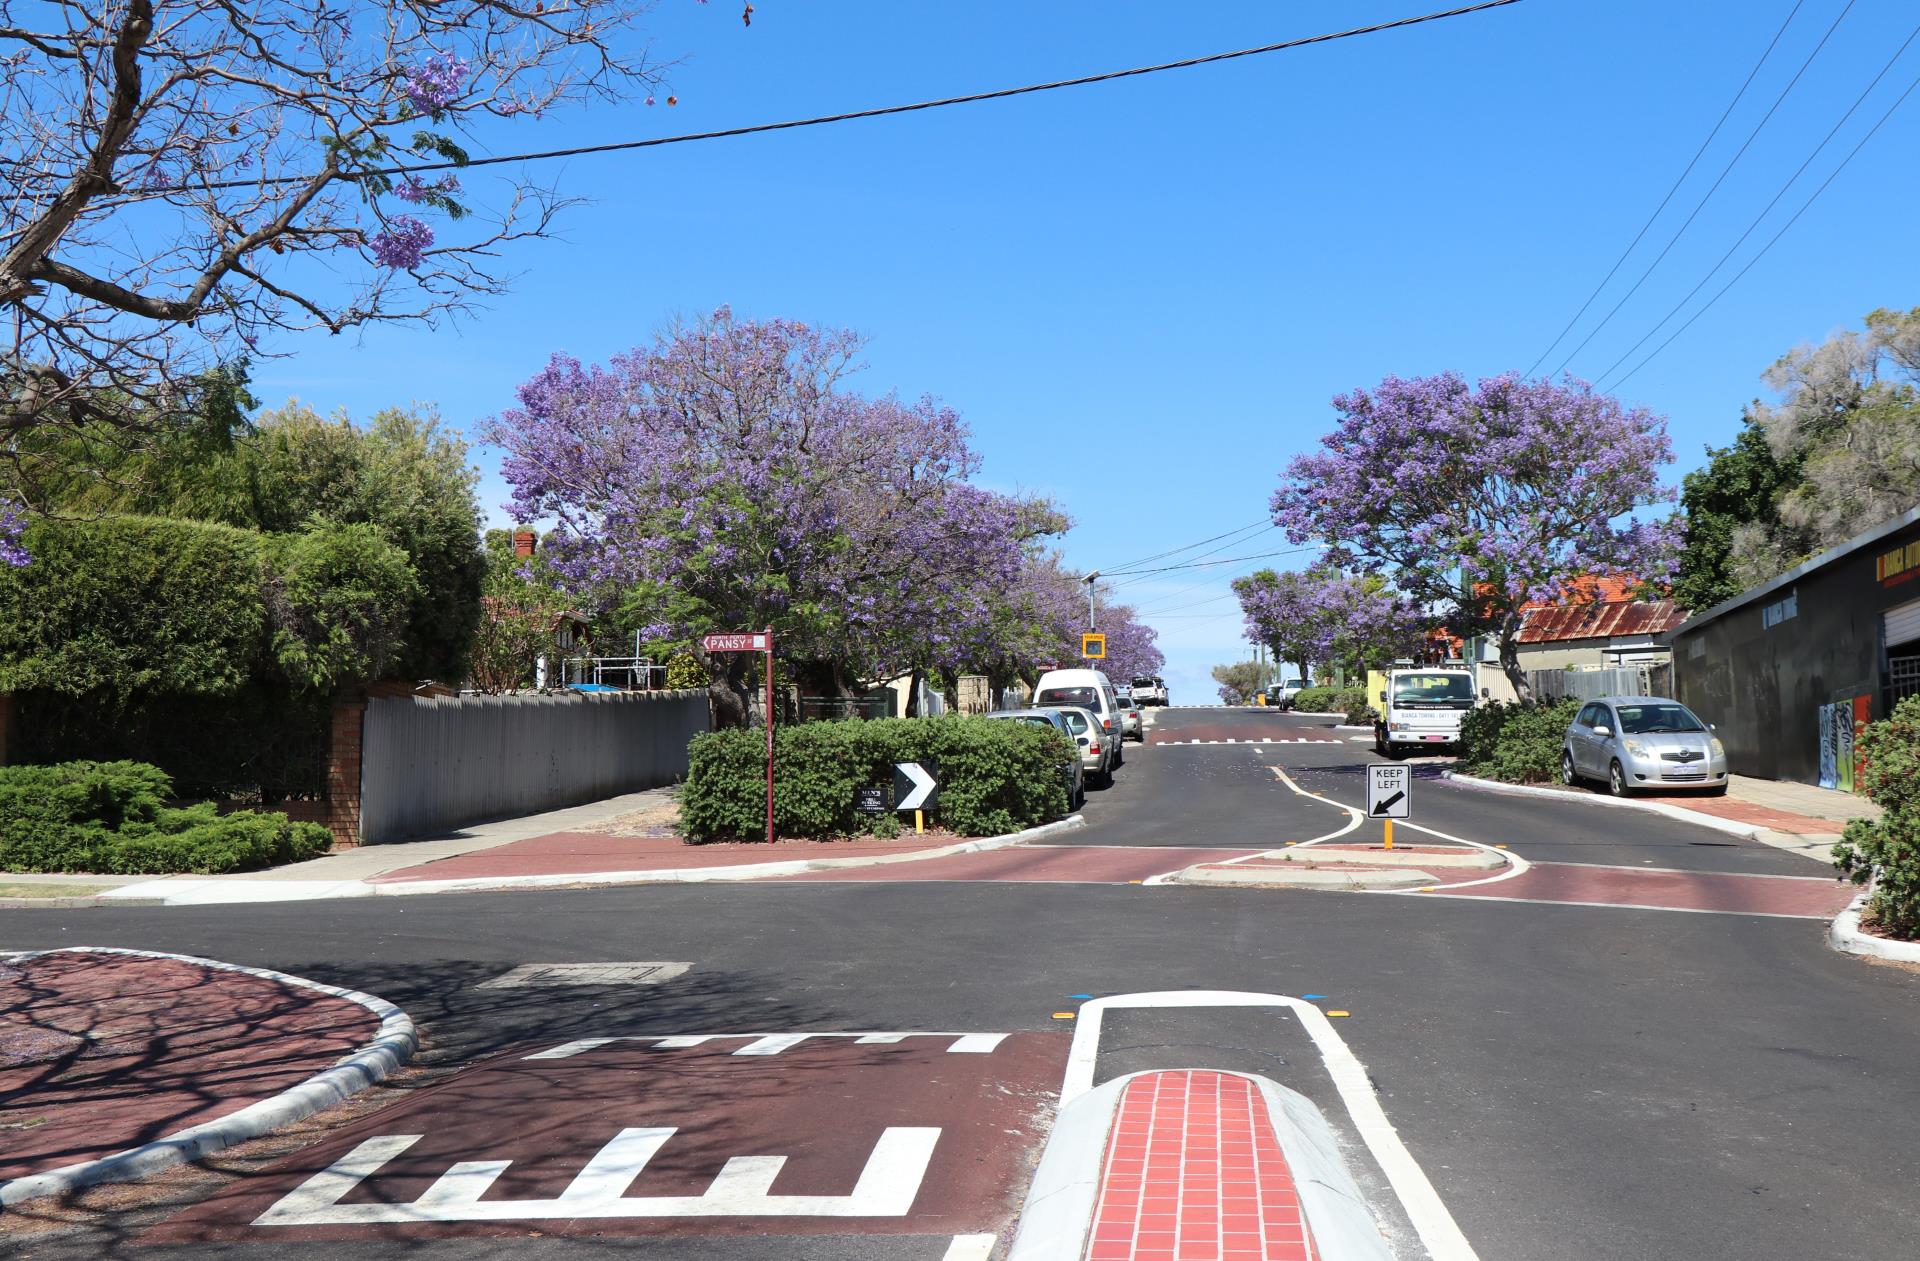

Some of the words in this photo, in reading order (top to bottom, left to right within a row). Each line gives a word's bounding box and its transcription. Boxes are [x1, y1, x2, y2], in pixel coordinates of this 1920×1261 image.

[710, 639, 746, 649] PANSY
[1376, 769, 1403, 778] KEEP
[1377, 780, 1401, 789] LEFT
